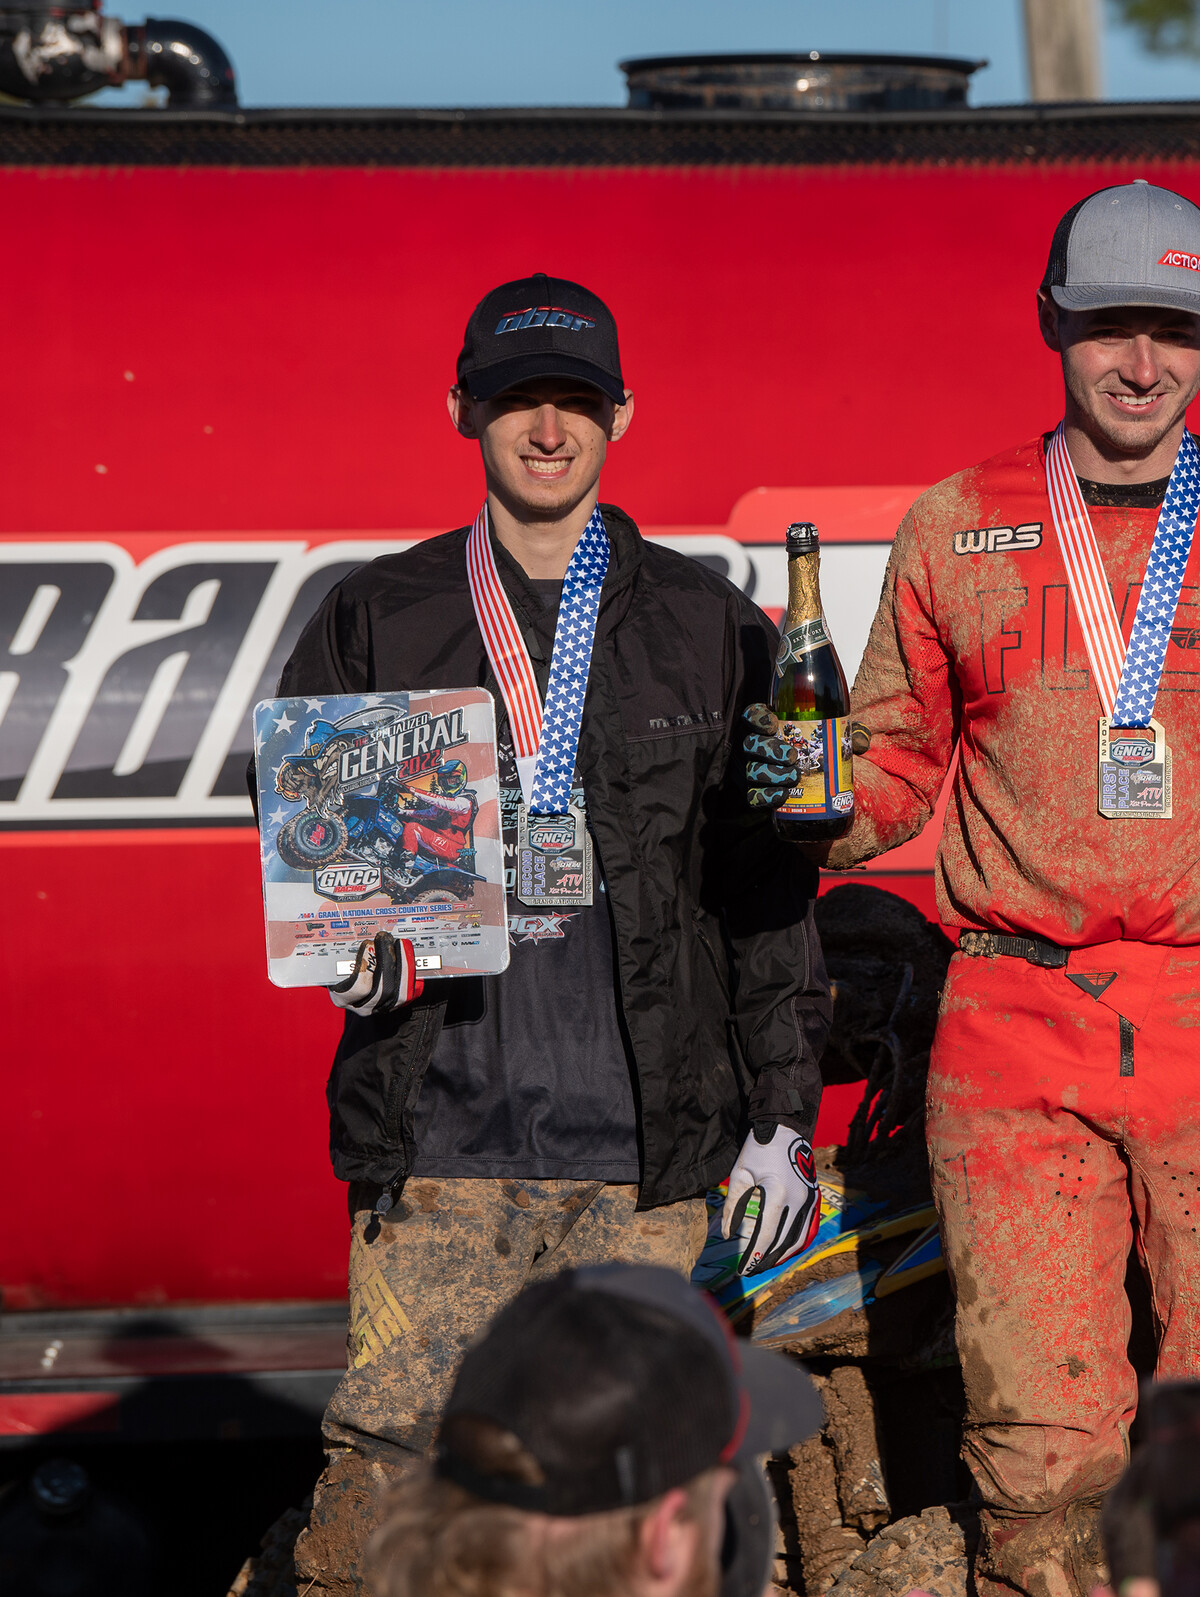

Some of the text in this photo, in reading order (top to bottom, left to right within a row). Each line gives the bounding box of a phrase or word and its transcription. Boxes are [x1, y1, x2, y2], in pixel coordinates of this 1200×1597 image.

[953, 522, 1043, 556] WPS
[370, 714, 428, 741] SPECIALIZED
[341, 712, 464, 781] GENERAL
[1113, 745, 1153, 757] GNCC
[399, 749, 441, 778] 2022
[1103, 763, 1117, 808] FIRST
[1118, 768, 1130, 809] PLACE
[1137, 787, 1162, 800] ATV
[531, 832, 572, 844] GNCC
[320, 869, 378, 888] GNCC
[522, 850, 532, 895] SECOND
[534, 856, 545, 896] PLACE
[556, 873, 583, 887] ATV
[333, 885, 366, 893] RACING
[318, 911, 341, 919] GRAND
[342, 908, 374, 918] NATIONAL
[376, 907, 397, 915] CROSS
[398, 905, 428, 914] COUNTRY
[430, 903, 452, 912] SERIES
